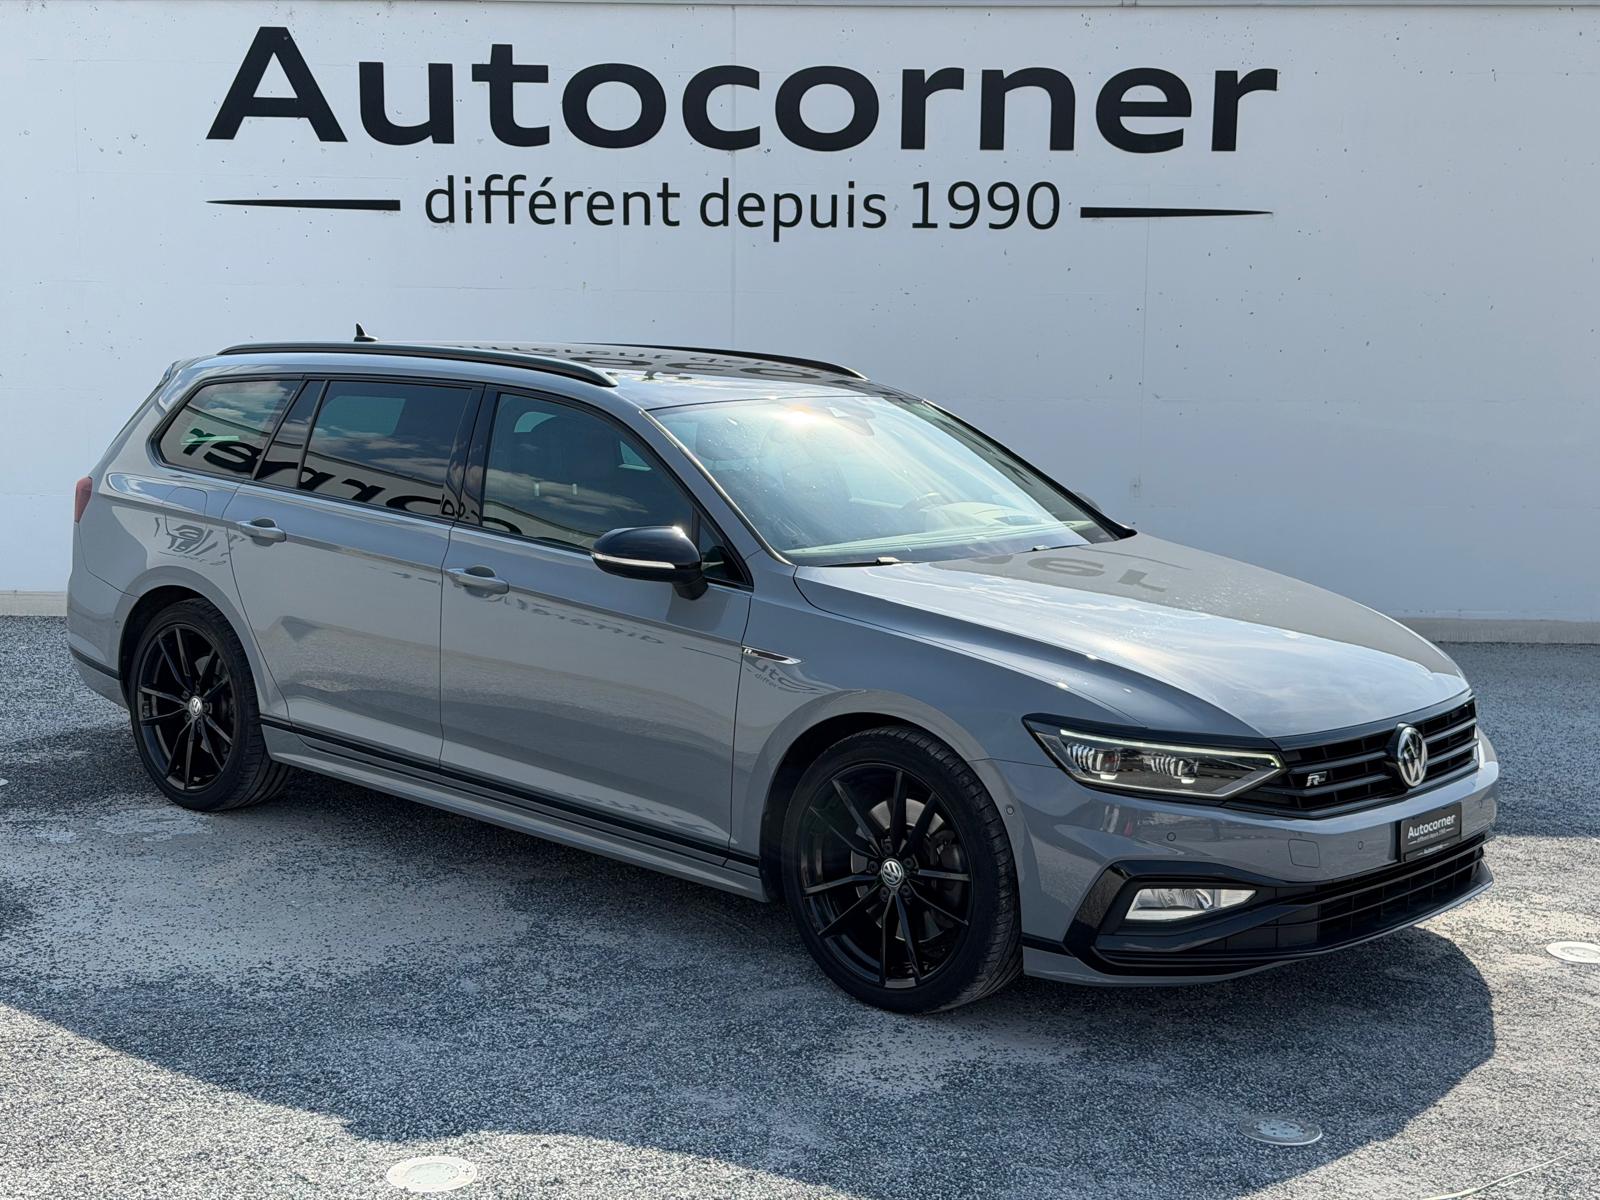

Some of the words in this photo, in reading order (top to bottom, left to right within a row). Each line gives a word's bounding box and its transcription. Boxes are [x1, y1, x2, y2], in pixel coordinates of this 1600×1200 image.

[206, 26, 1278, 154] Autocorner
[425, 173, 681, 227] différent
[699, 177, 887, 243] depuis
[912, 181, 1060, 230] 1990
[1407, 814, 1456, 840] Autocorner
